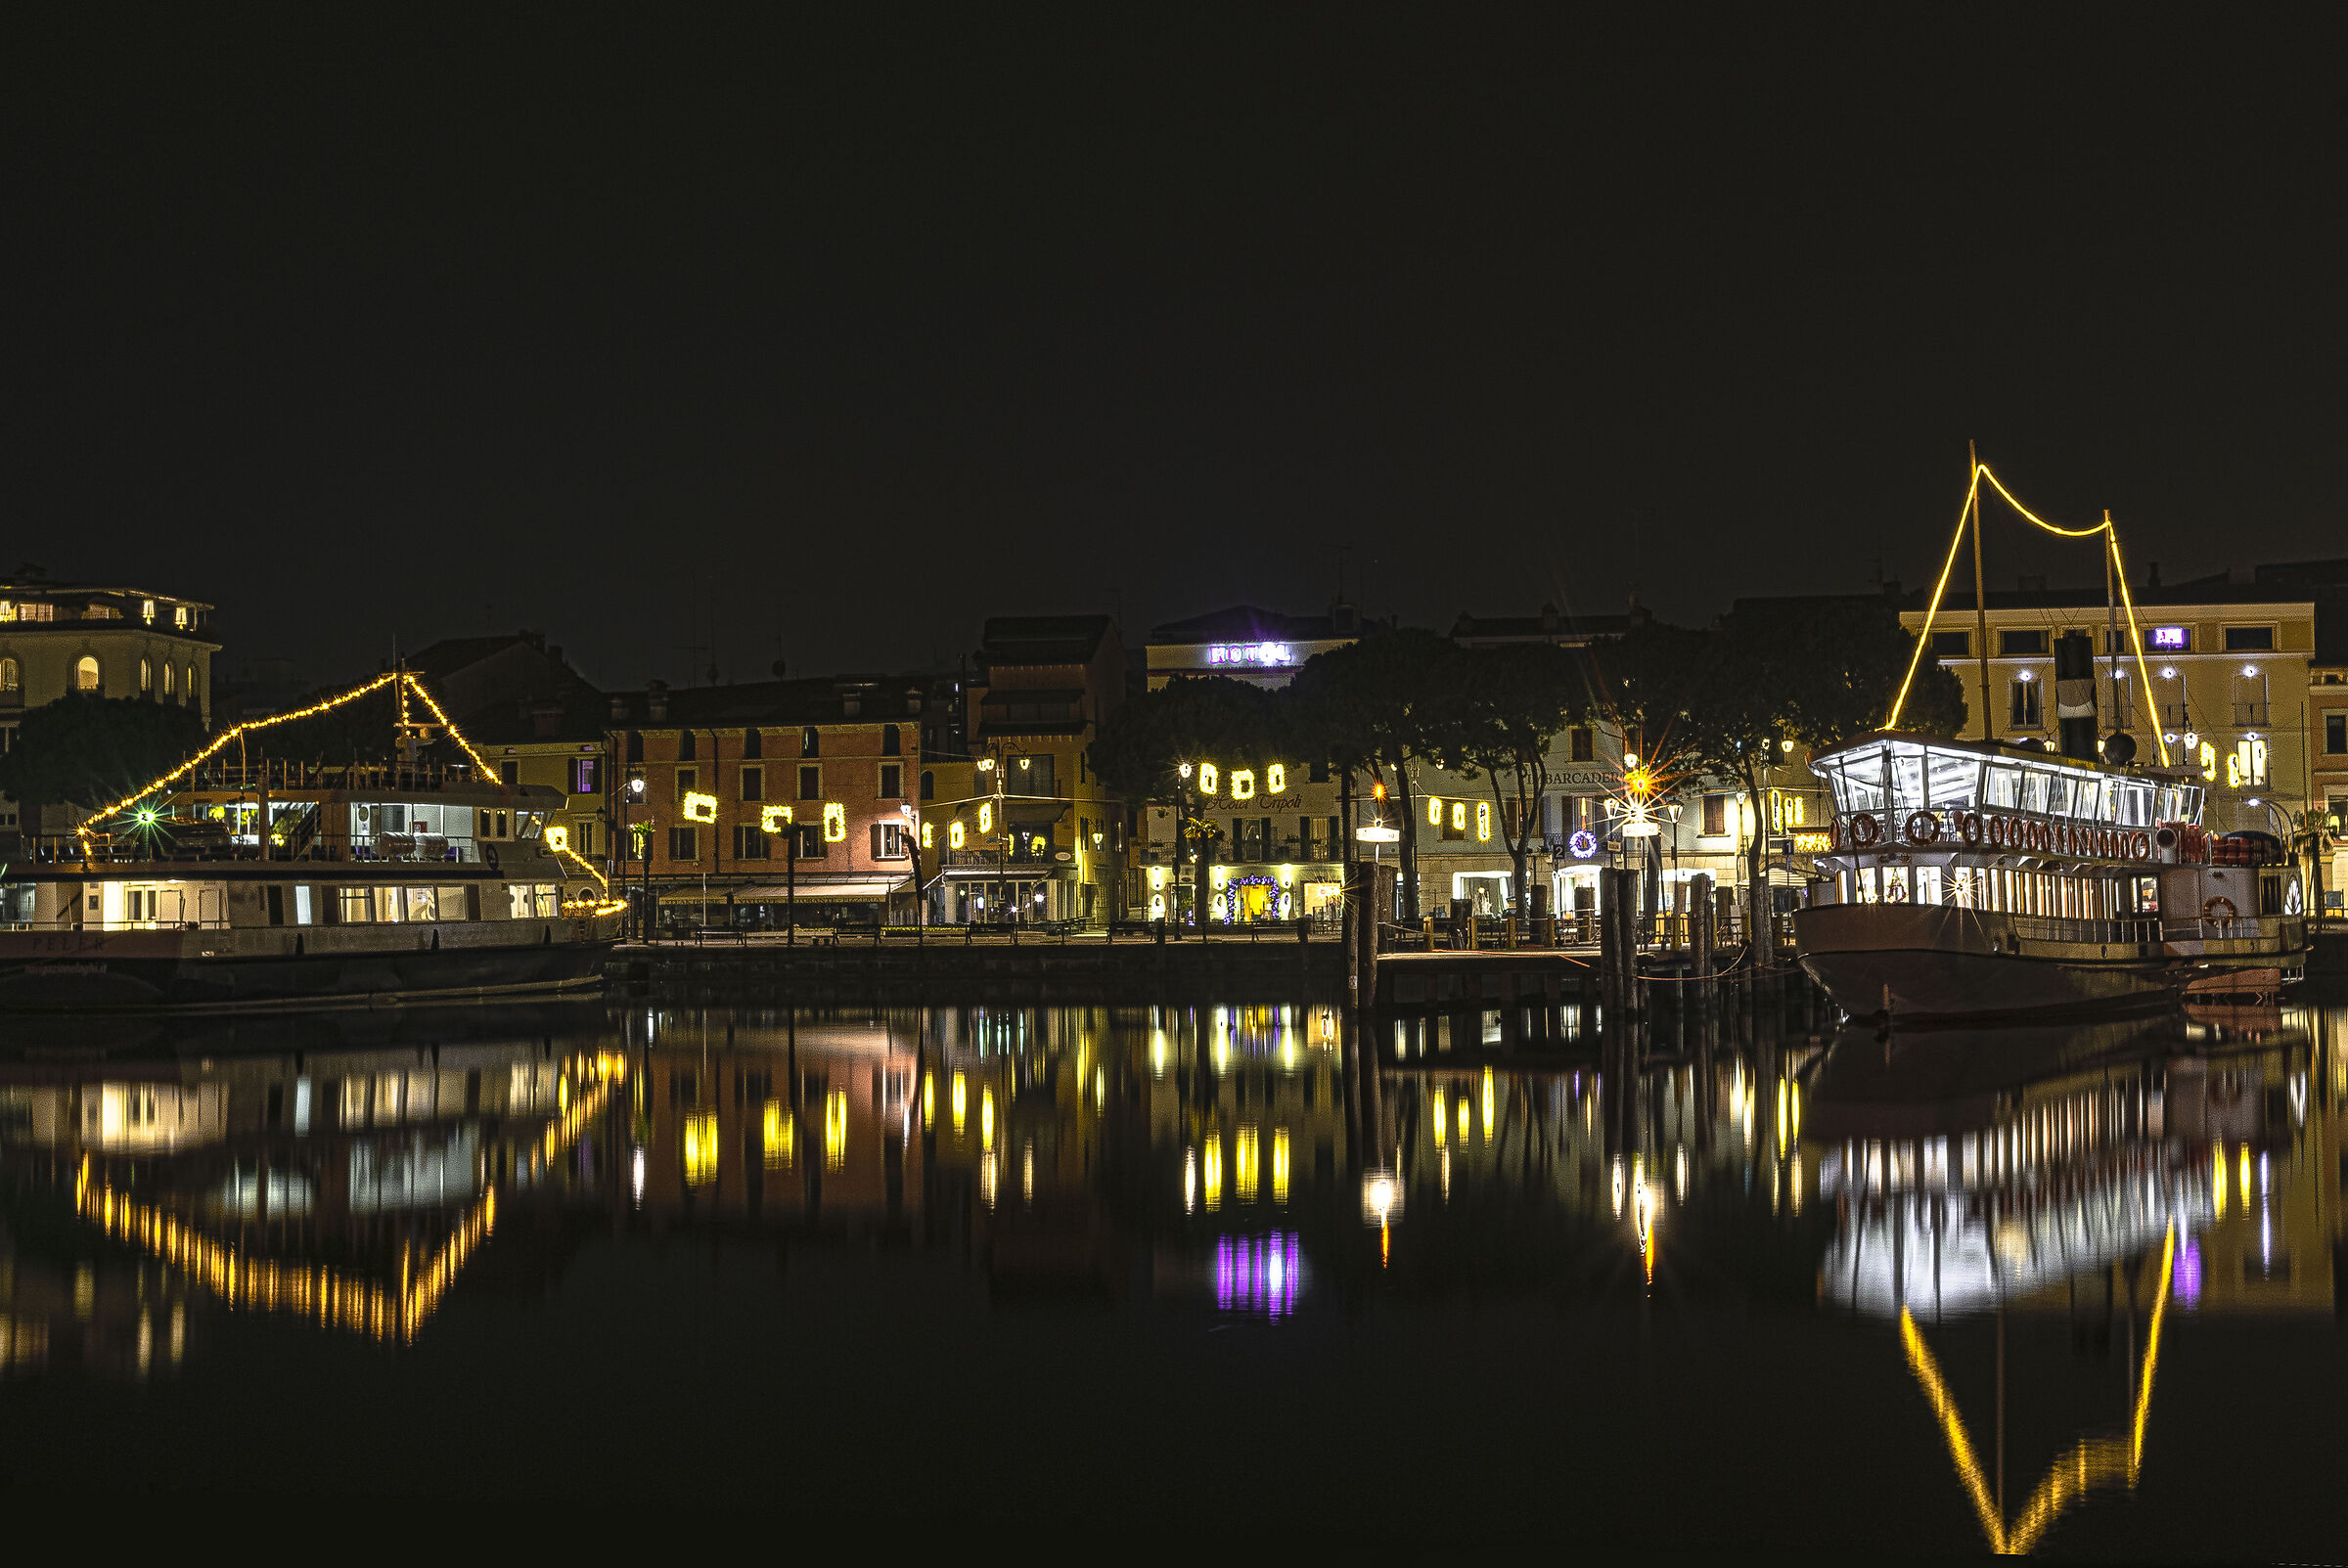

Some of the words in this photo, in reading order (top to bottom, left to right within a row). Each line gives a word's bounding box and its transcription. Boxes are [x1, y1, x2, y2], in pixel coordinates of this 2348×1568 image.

[1255, 793, 1302, 814] Tripoli
[1556, 846, 1563, 858] 2
[32, 936, 104, 951] PELER
